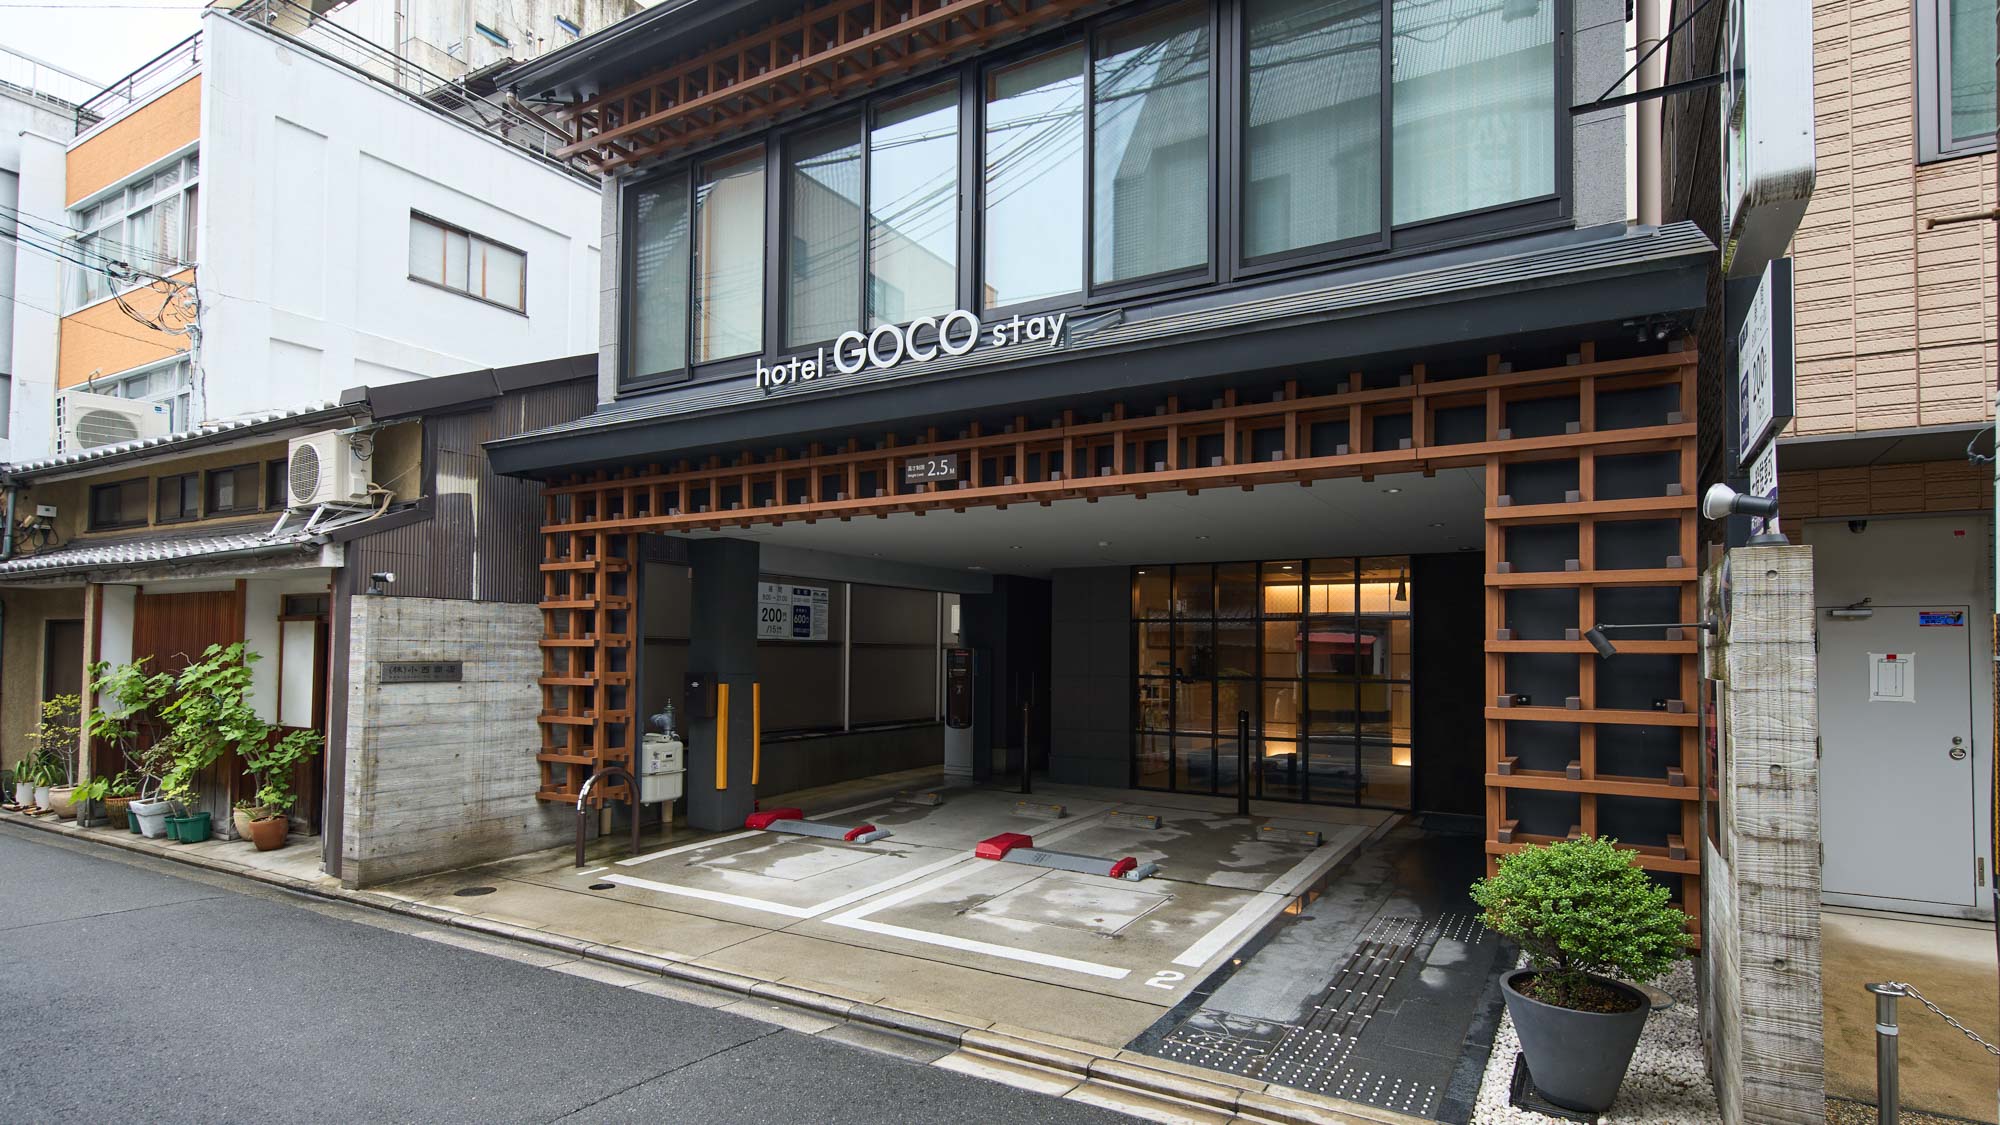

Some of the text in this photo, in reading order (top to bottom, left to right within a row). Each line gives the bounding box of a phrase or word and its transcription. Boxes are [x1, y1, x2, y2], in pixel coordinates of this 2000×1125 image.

[756, 309, 1067, 388] hotel GOCO stay
[928, 459, 948, 476] 2.5
[1144, 970, 1186, 990] 2
